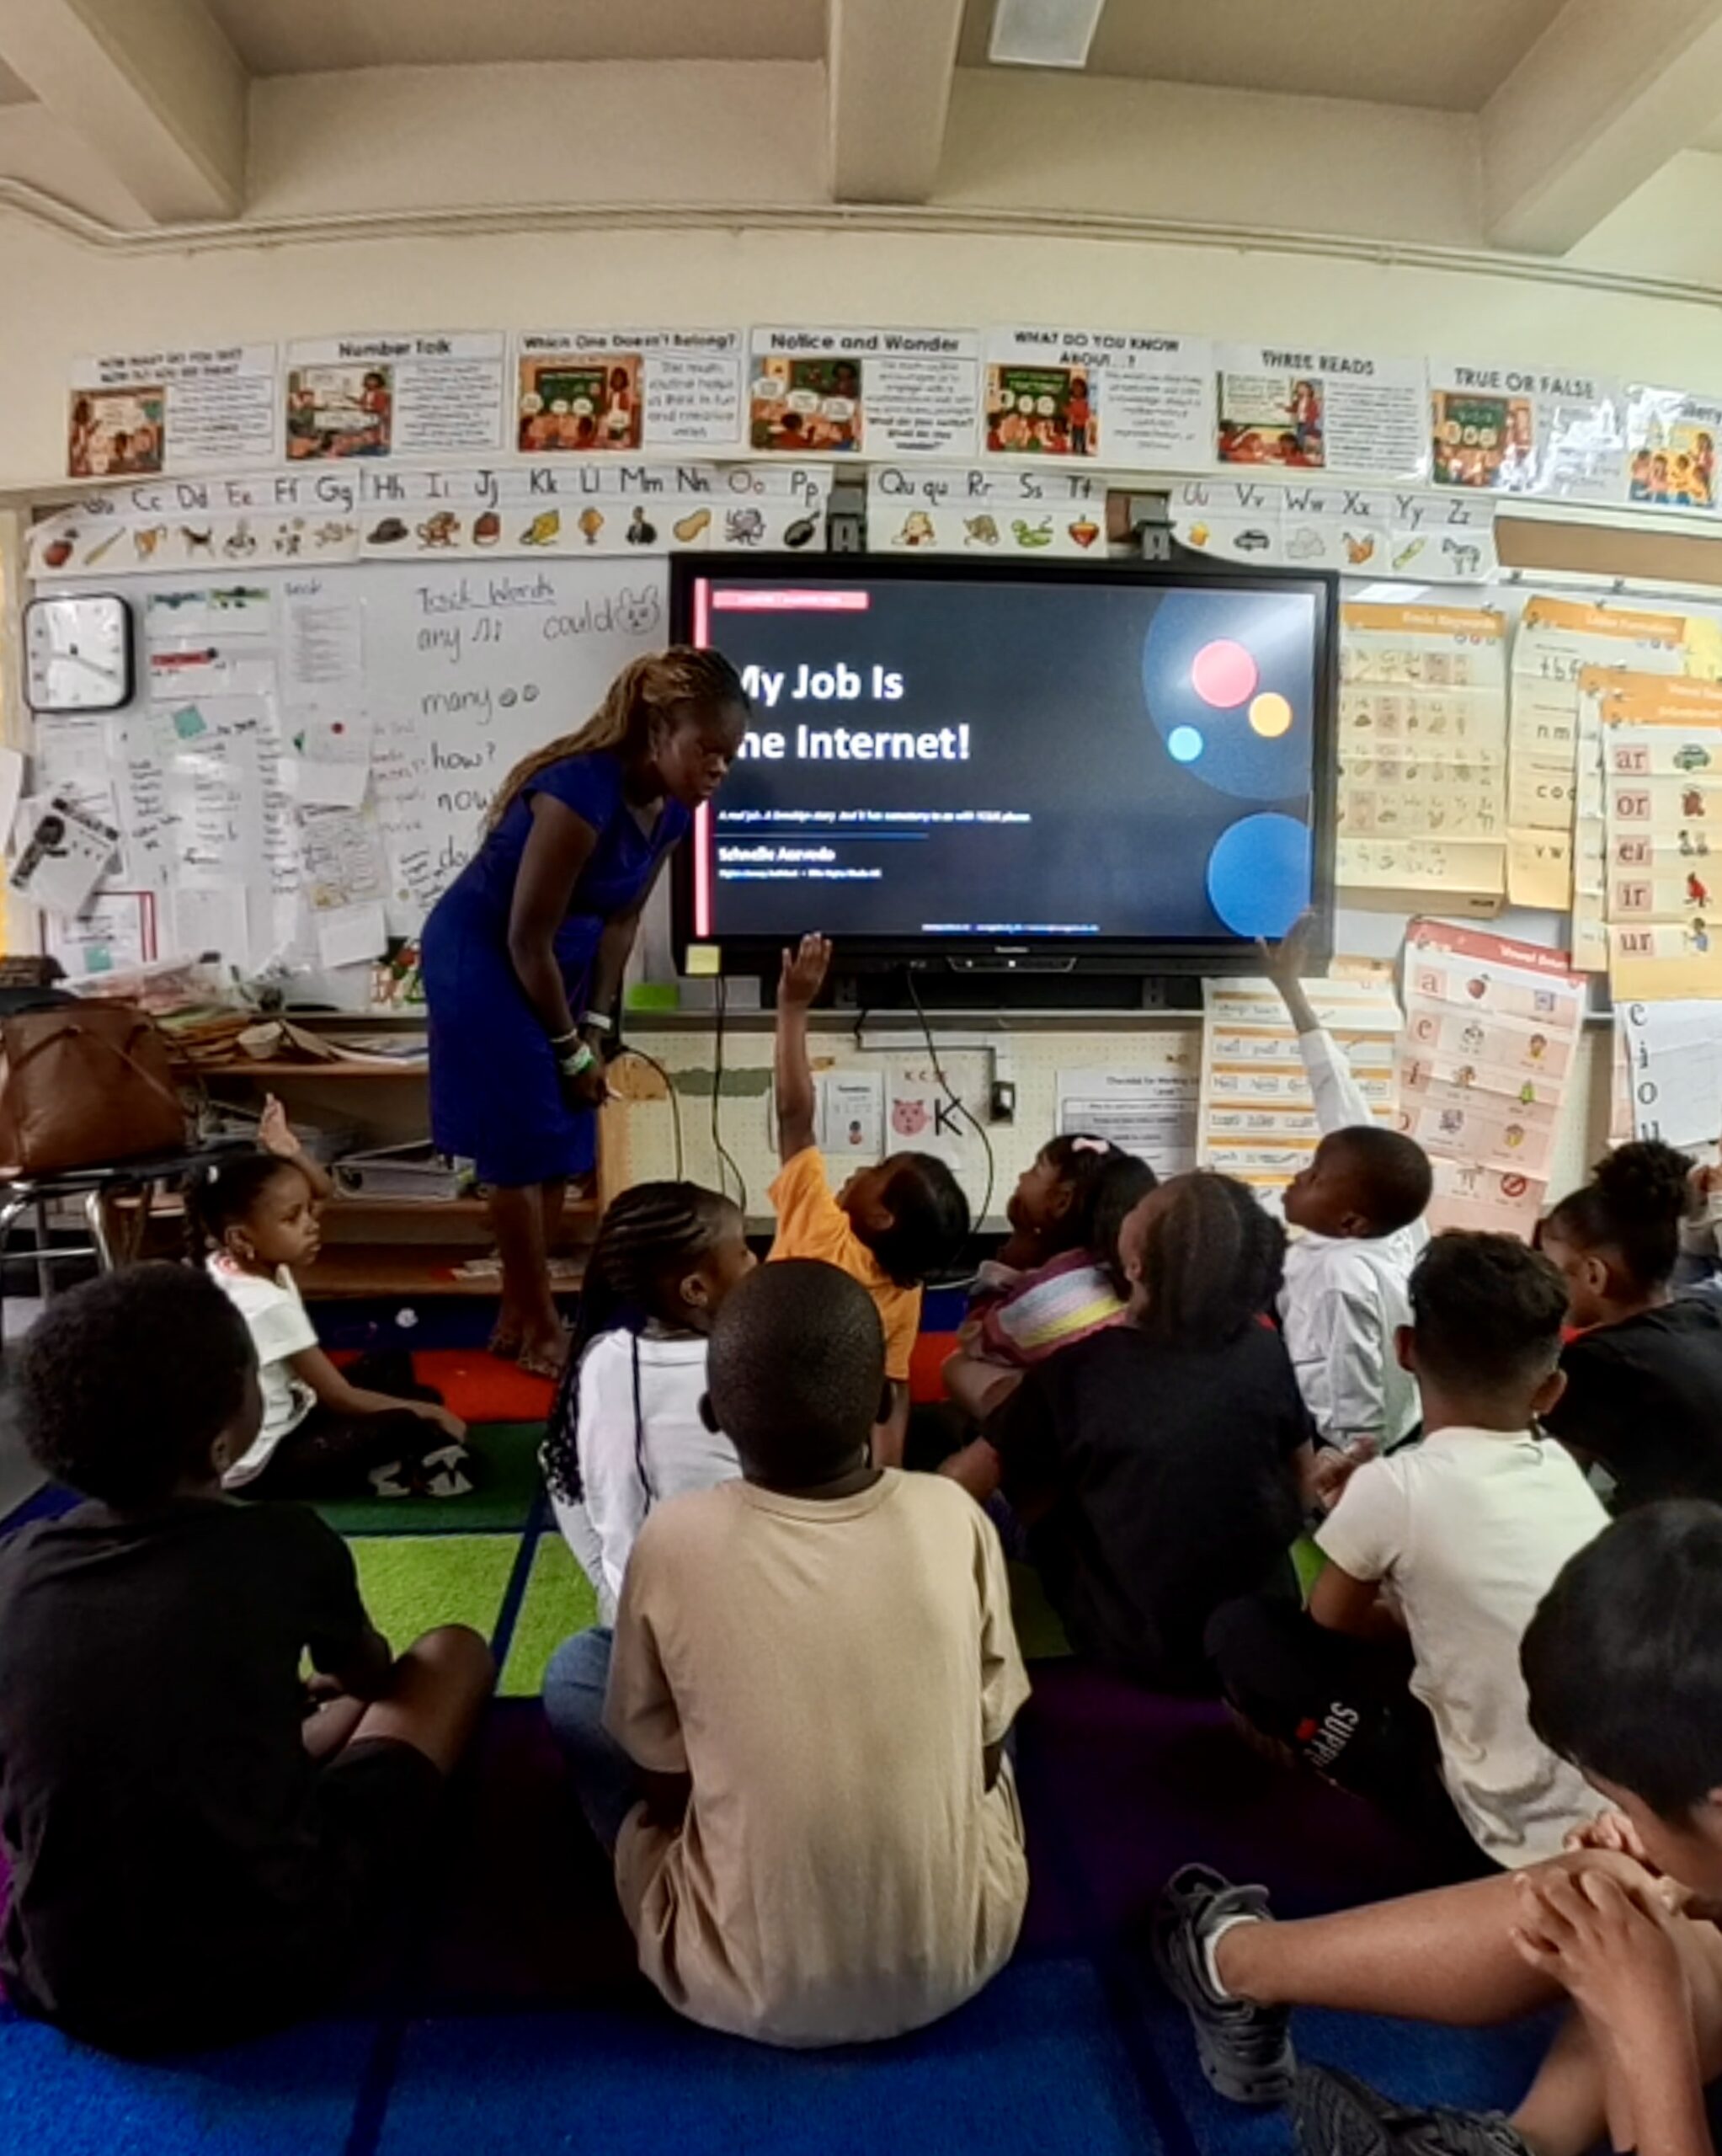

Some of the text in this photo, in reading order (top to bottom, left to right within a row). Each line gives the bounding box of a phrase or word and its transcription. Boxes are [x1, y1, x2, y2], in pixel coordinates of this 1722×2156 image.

[339, 340, 410, 359] Number
[613, 334, 670, 348] Doesn't
[771, 334, 960, 352] Notice and Wonder
[1014, 331, 1180, 352] WHAT DO YOU KNOW
[1261, 350, 1375, 376] THREE READS
[1454, 366, 1596, 400] TRUE OR FALSE
[131, 487, 162, 511] Cc
[177, 483, 208, 510] Dd
[227, 484, 253, 507] Ee
[275, 477, 300, 502] Ff
[316, 475, 354, 513] Gg
[373, 474, 405, 499] Hh
[425, 472, 450, 498] Ii
[475, 469, 499, 507] Jj
[529, 468, 559, 494] Kk
[620, 467, 664, 494] Mm
[677, 468, 711, 494] Nn
[728, 469, 765, 494] Oo
[791, 470, 819, 505] Pp
[878, 467, 1092, 507] Qu qu Rr Ss Tt
[1183, 482, 1472, 530] Uu Vv Ww Xx Yy Zz
[542, 599, 614, 642] could
[418, 627, 461, 664] any
[792, 662, 861, 700] Job
[872, 665, 905, 699] Is
[423, 687, 493, 726] many
[797, 724, 971, 760] Internet!
[1553, 725, 1570, 741] m
[431, 740, 496, 770] how?
[1616, 750, 1647, 770] ar
[1616, 795, 1649, 817] or
[1618, 841, 1647, 861] er
[1622, 884, 1647, 908] ir
[1619, 932, 1652, 952] ur
[1421, 973, 1438, 994] a
[1637, 1081, 1659, 1105] o
[934, 1097, 963, 1137] K
